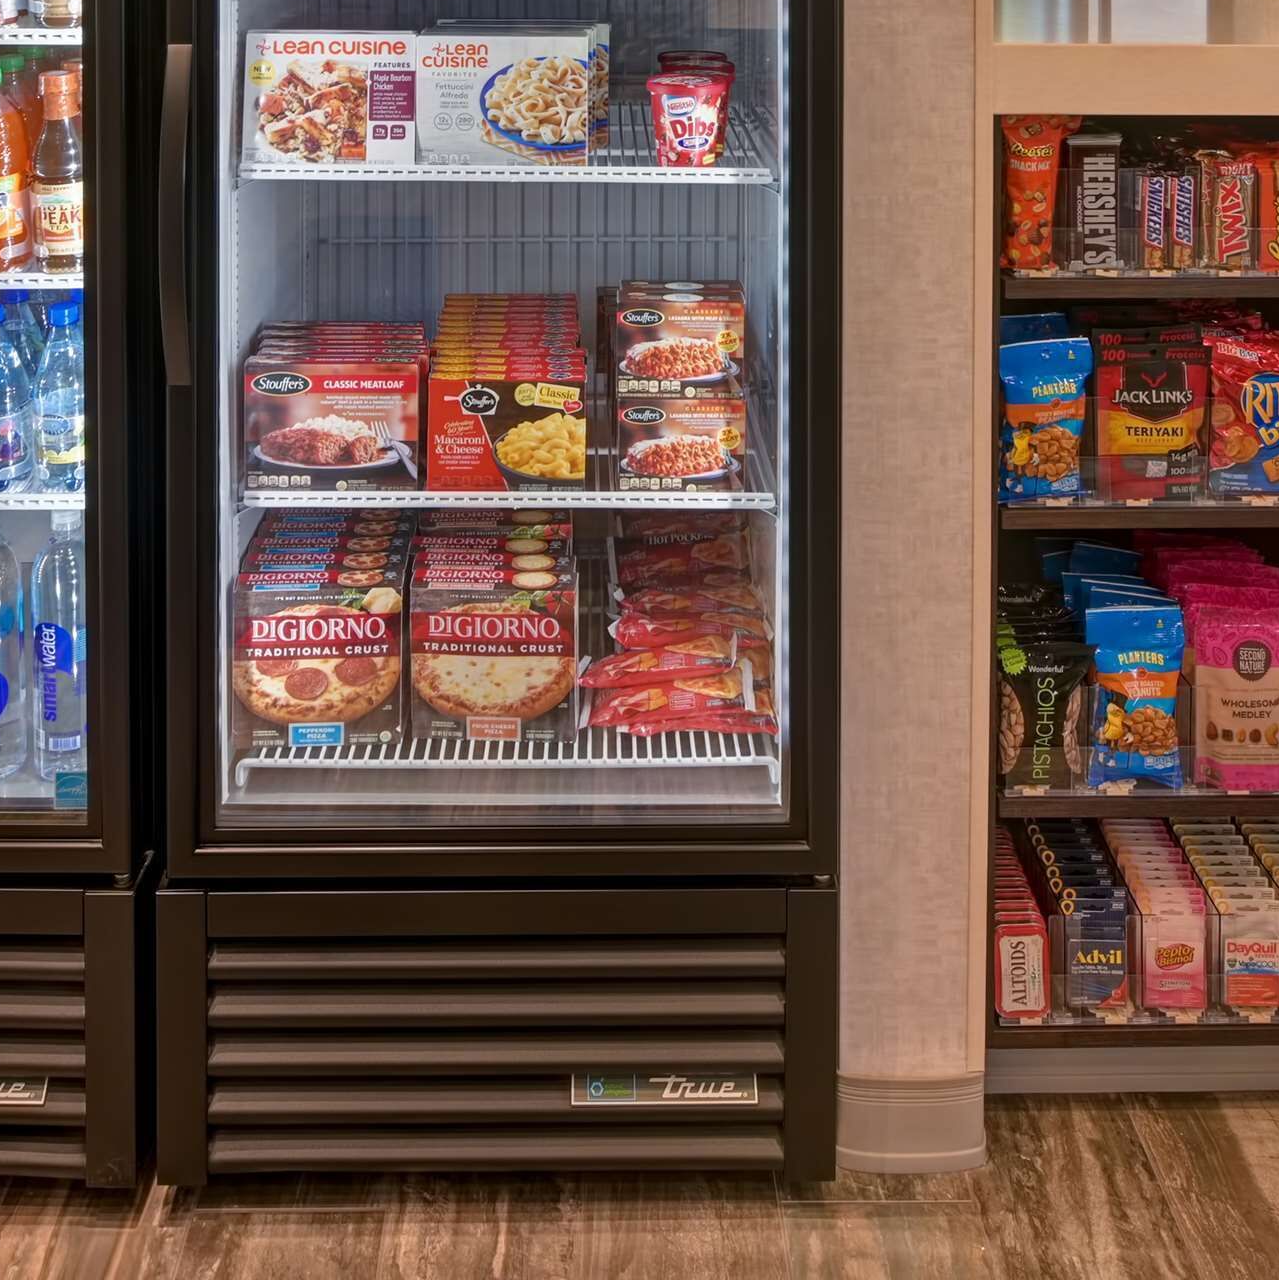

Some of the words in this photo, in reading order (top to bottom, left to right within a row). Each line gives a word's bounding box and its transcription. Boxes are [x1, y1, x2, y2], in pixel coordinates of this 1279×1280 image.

[373, 74, 389, 83] Maple
[390, 74, 412, 82] Bourbon
[435, 83, 474, 91] Fettuccini
[439, 91, 469, 100] Alfredo
[670, 116, 716, 139] Dibs
[1083, 157, 1117, 266] HERSHEY'S
[1146, 176, 1163, 246] SNICKERS
[625, 312, 659, 324] Stouffer's
[1101, 349, 1125, 361] 100
[1165, 350, 1205, 360] Protein
[258, 377, 305, 391] Stouffer's
[323, 380, 357, 389] CLASSIC
[360, 380, 405, 389] MEATLOAF
[539, 387, 576, 400] Classic
[1112, 390, 1151, 404] JACK
[627, 410, 661, 421] Stouffer's
[1125, 425, 1184, 437] TERIYAKI
[434, 434, 485, 445] Macaroni
[435, 445, 444, 454] &
[445, 444, 484, 454] Cheese
[422, 536, 498, 545] DIGIORNO
[648, 535, 668, 545] HOT
[256, 552, 335, 562] DIGIORNO
[426, 552, 504, 562] DIGIORNO
[248, 571, 329, 581] DIGIORNO
[426, 570, 505, 579] DIGIORNO
[246, 646, 339, 657] TRADITIONAL
[345, 644, 389, 655] CRUST
[423, 642, 515, 653] TRADITIONAL
[520, 644, 564, 654] CRUST
[1118, 649, 1165, 666] PLANTERS
[1239, 649, 1266, 661] SECOND
[1028, 664, 1064, 674] Wonderful
[1239, 660, 1266, 672] NATURE
[1232, 710, 1271, 719] MEDLEY
[1032, 677, 1056, 779] PISTACHIOS
[1226, 942, 1277, 957] DayQuil
[1072, 949, 1123, 965] Advil
[1159, 954, 1194, 967] Bismol
[1009, 939, 1027, 1006] ALTOIDS
